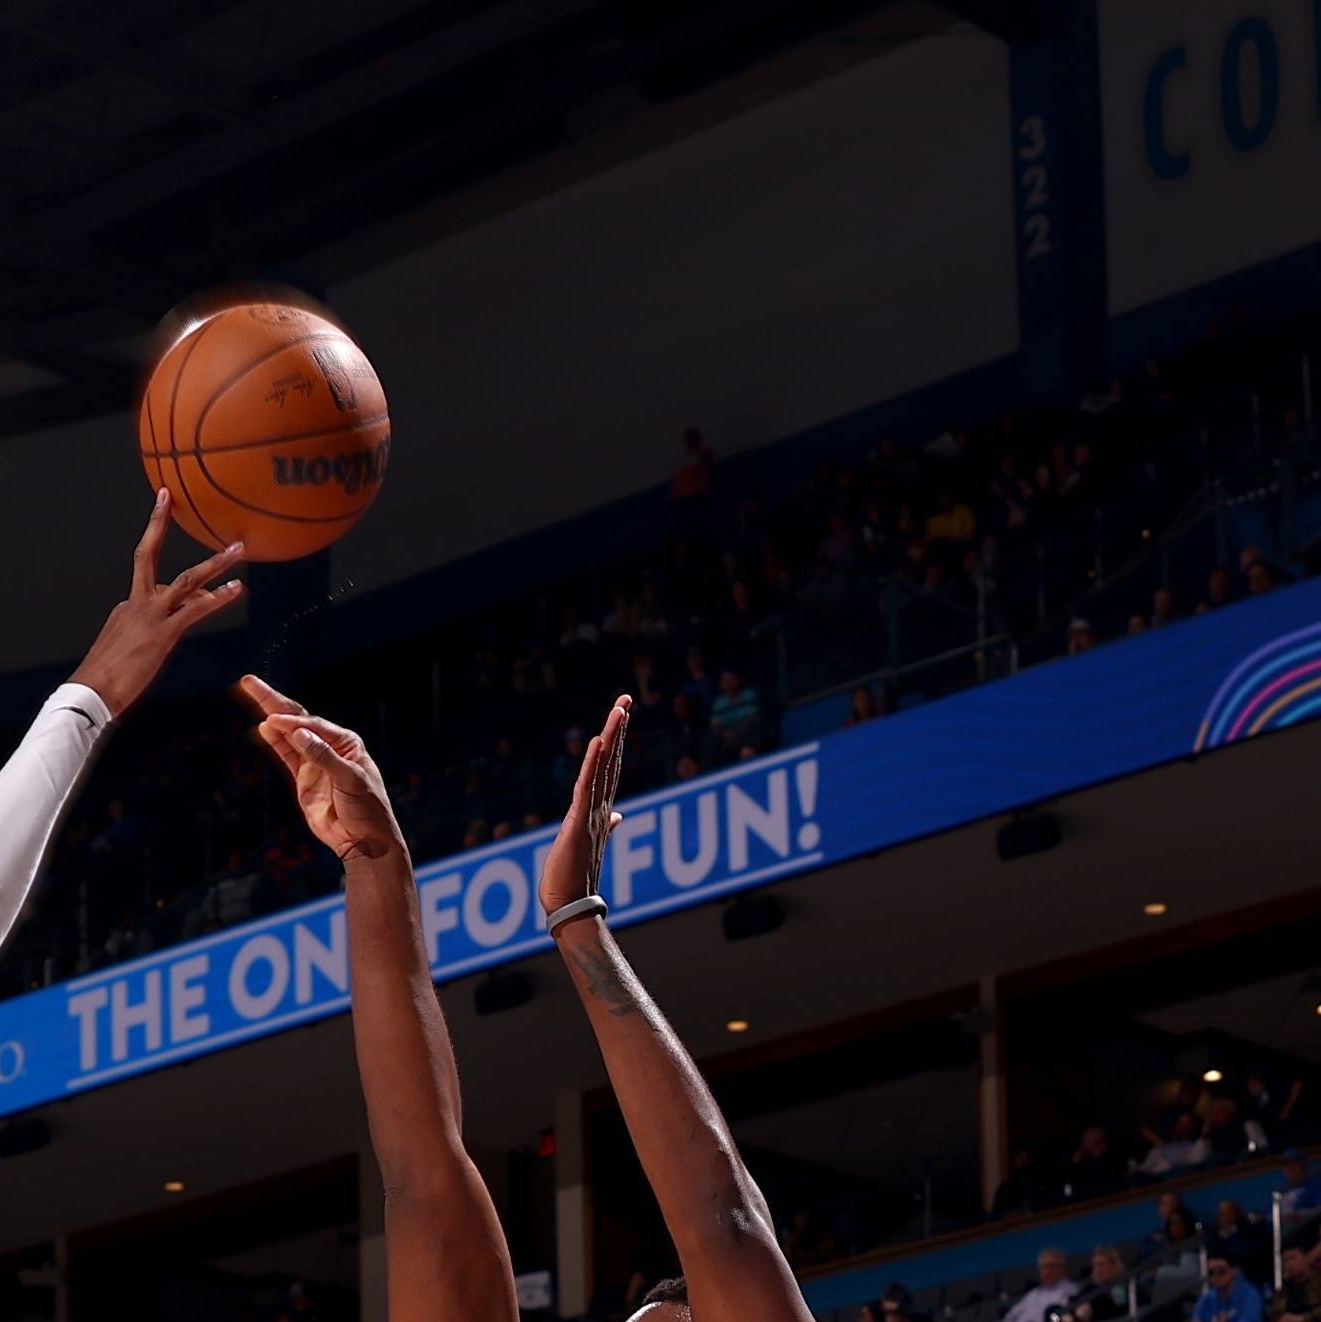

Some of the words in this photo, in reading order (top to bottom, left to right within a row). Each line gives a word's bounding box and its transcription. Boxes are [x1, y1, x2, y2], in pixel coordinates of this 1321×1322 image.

[1144, 15, 1321, 181] CO
[1018, 114, 1052, 261] 322
[67, 954, 210, 1072] THE
[229, 910, 349, 1020] ON
[420, 846, 551, 966] FO
[611, 759, 823, 907] FUN!
